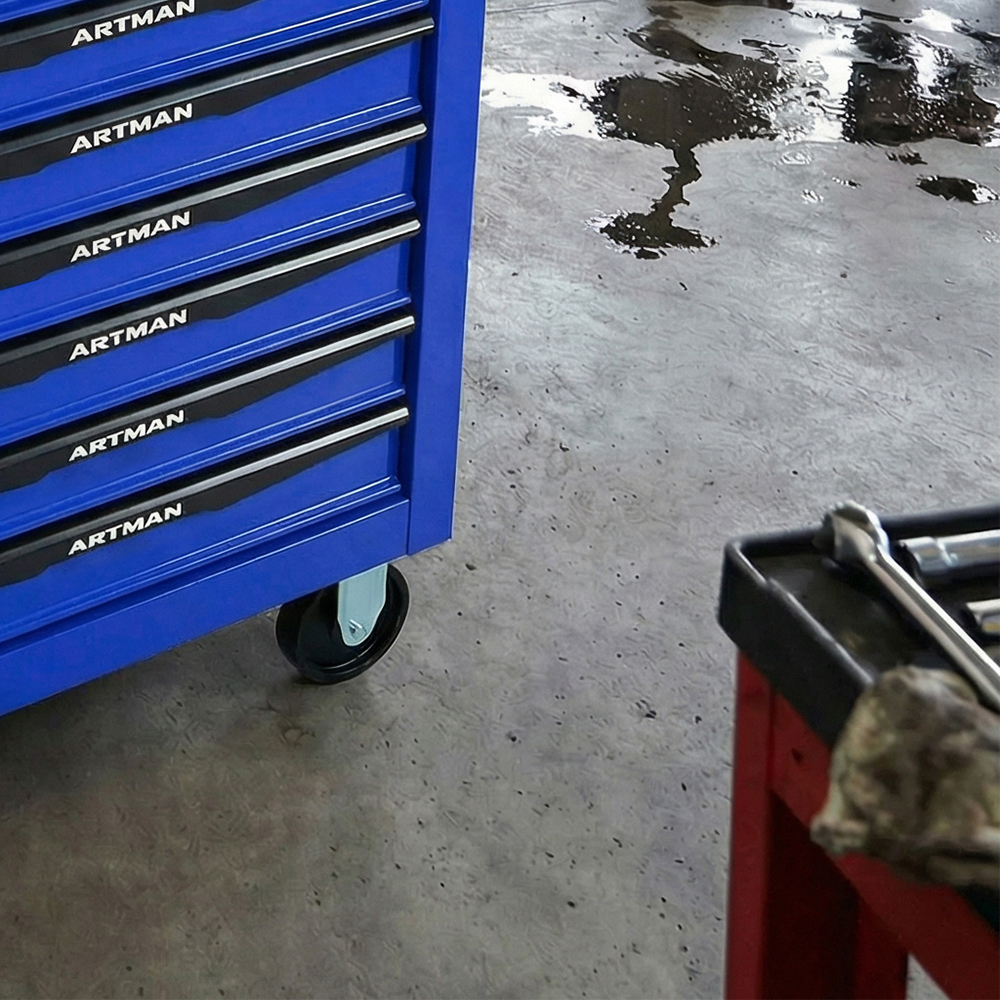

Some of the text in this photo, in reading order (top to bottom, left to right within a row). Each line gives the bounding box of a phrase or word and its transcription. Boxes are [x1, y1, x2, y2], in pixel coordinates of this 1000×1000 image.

[70, 102, 193, 154] ARTMAN
[70, 210, 191, 263] ARTMAN
[68, 308, 188, 361] ARTMAN
[68, 409, 185, 462] ARTMAN
[67, 502, 182, 556] ARTMAN
